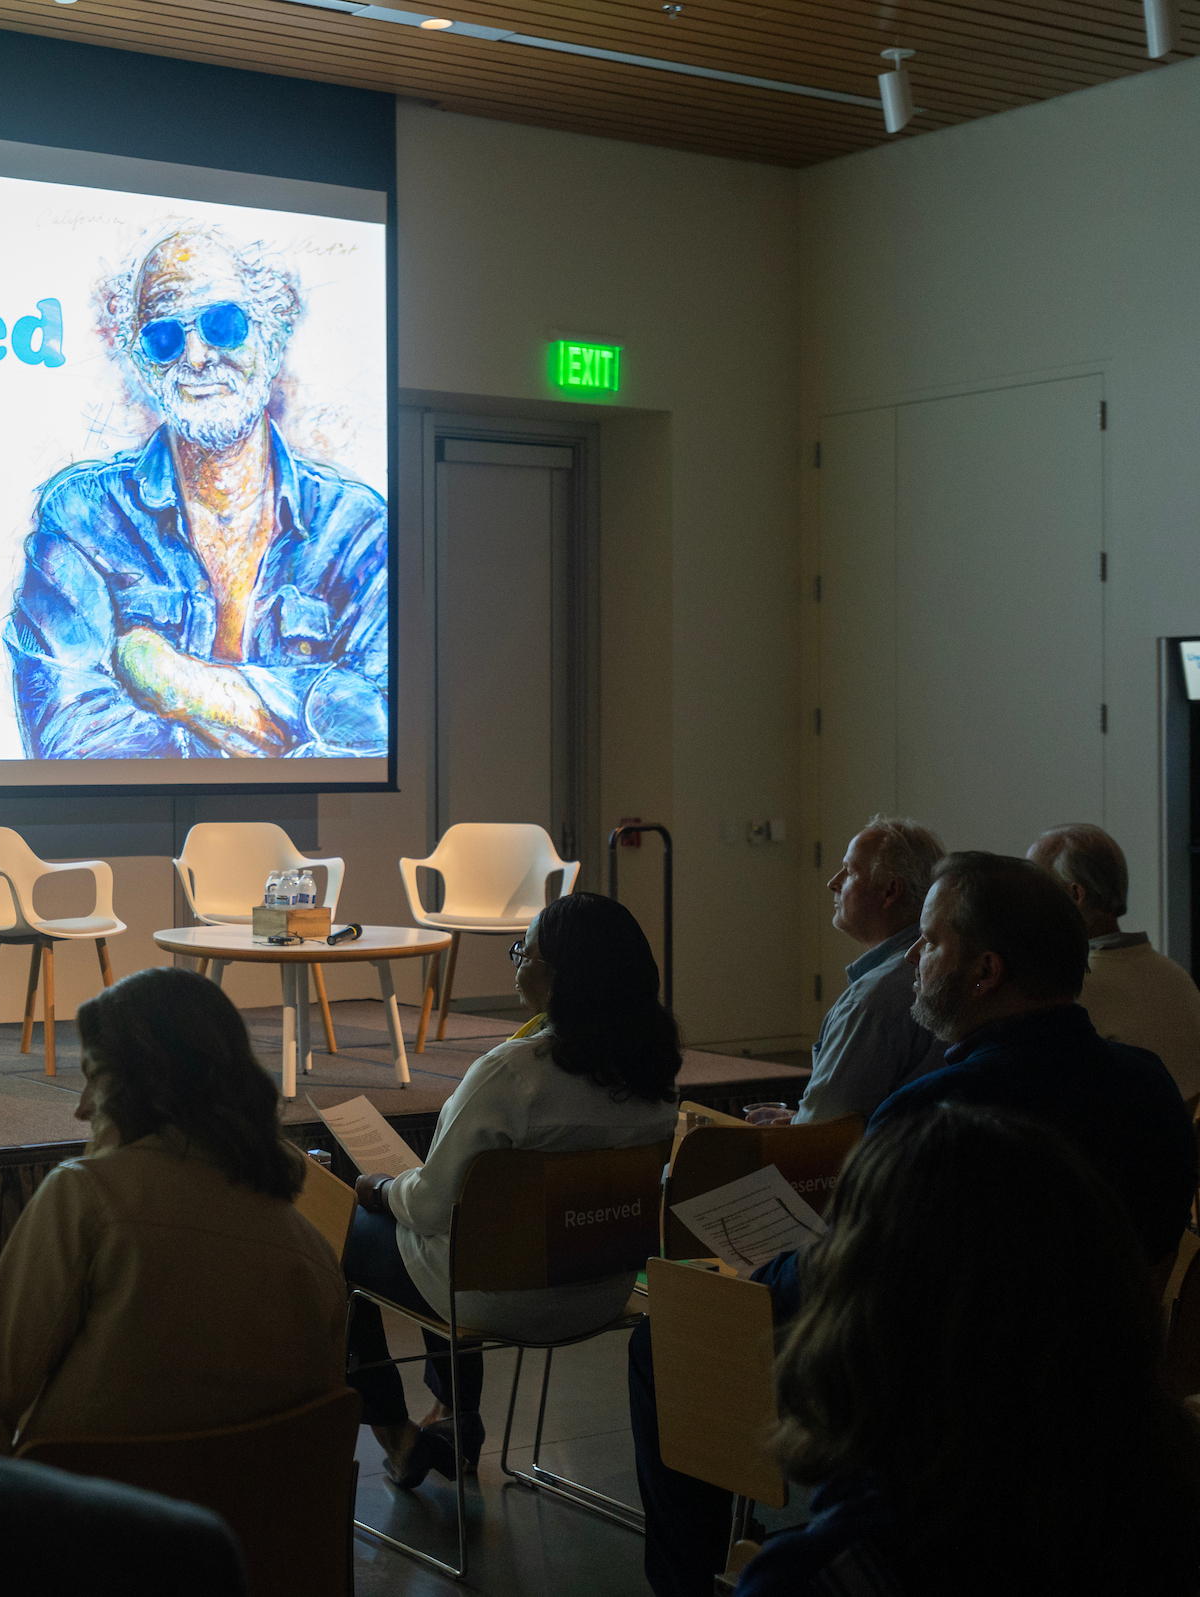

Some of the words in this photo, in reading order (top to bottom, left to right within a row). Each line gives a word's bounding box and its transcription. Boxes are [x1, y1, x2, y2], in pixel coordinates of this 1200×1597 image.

[568, 346, 613, 388] EXIT
[790, 1176, 837, 1194] eserve
[564, 1198, 642, 1229] Reserved
